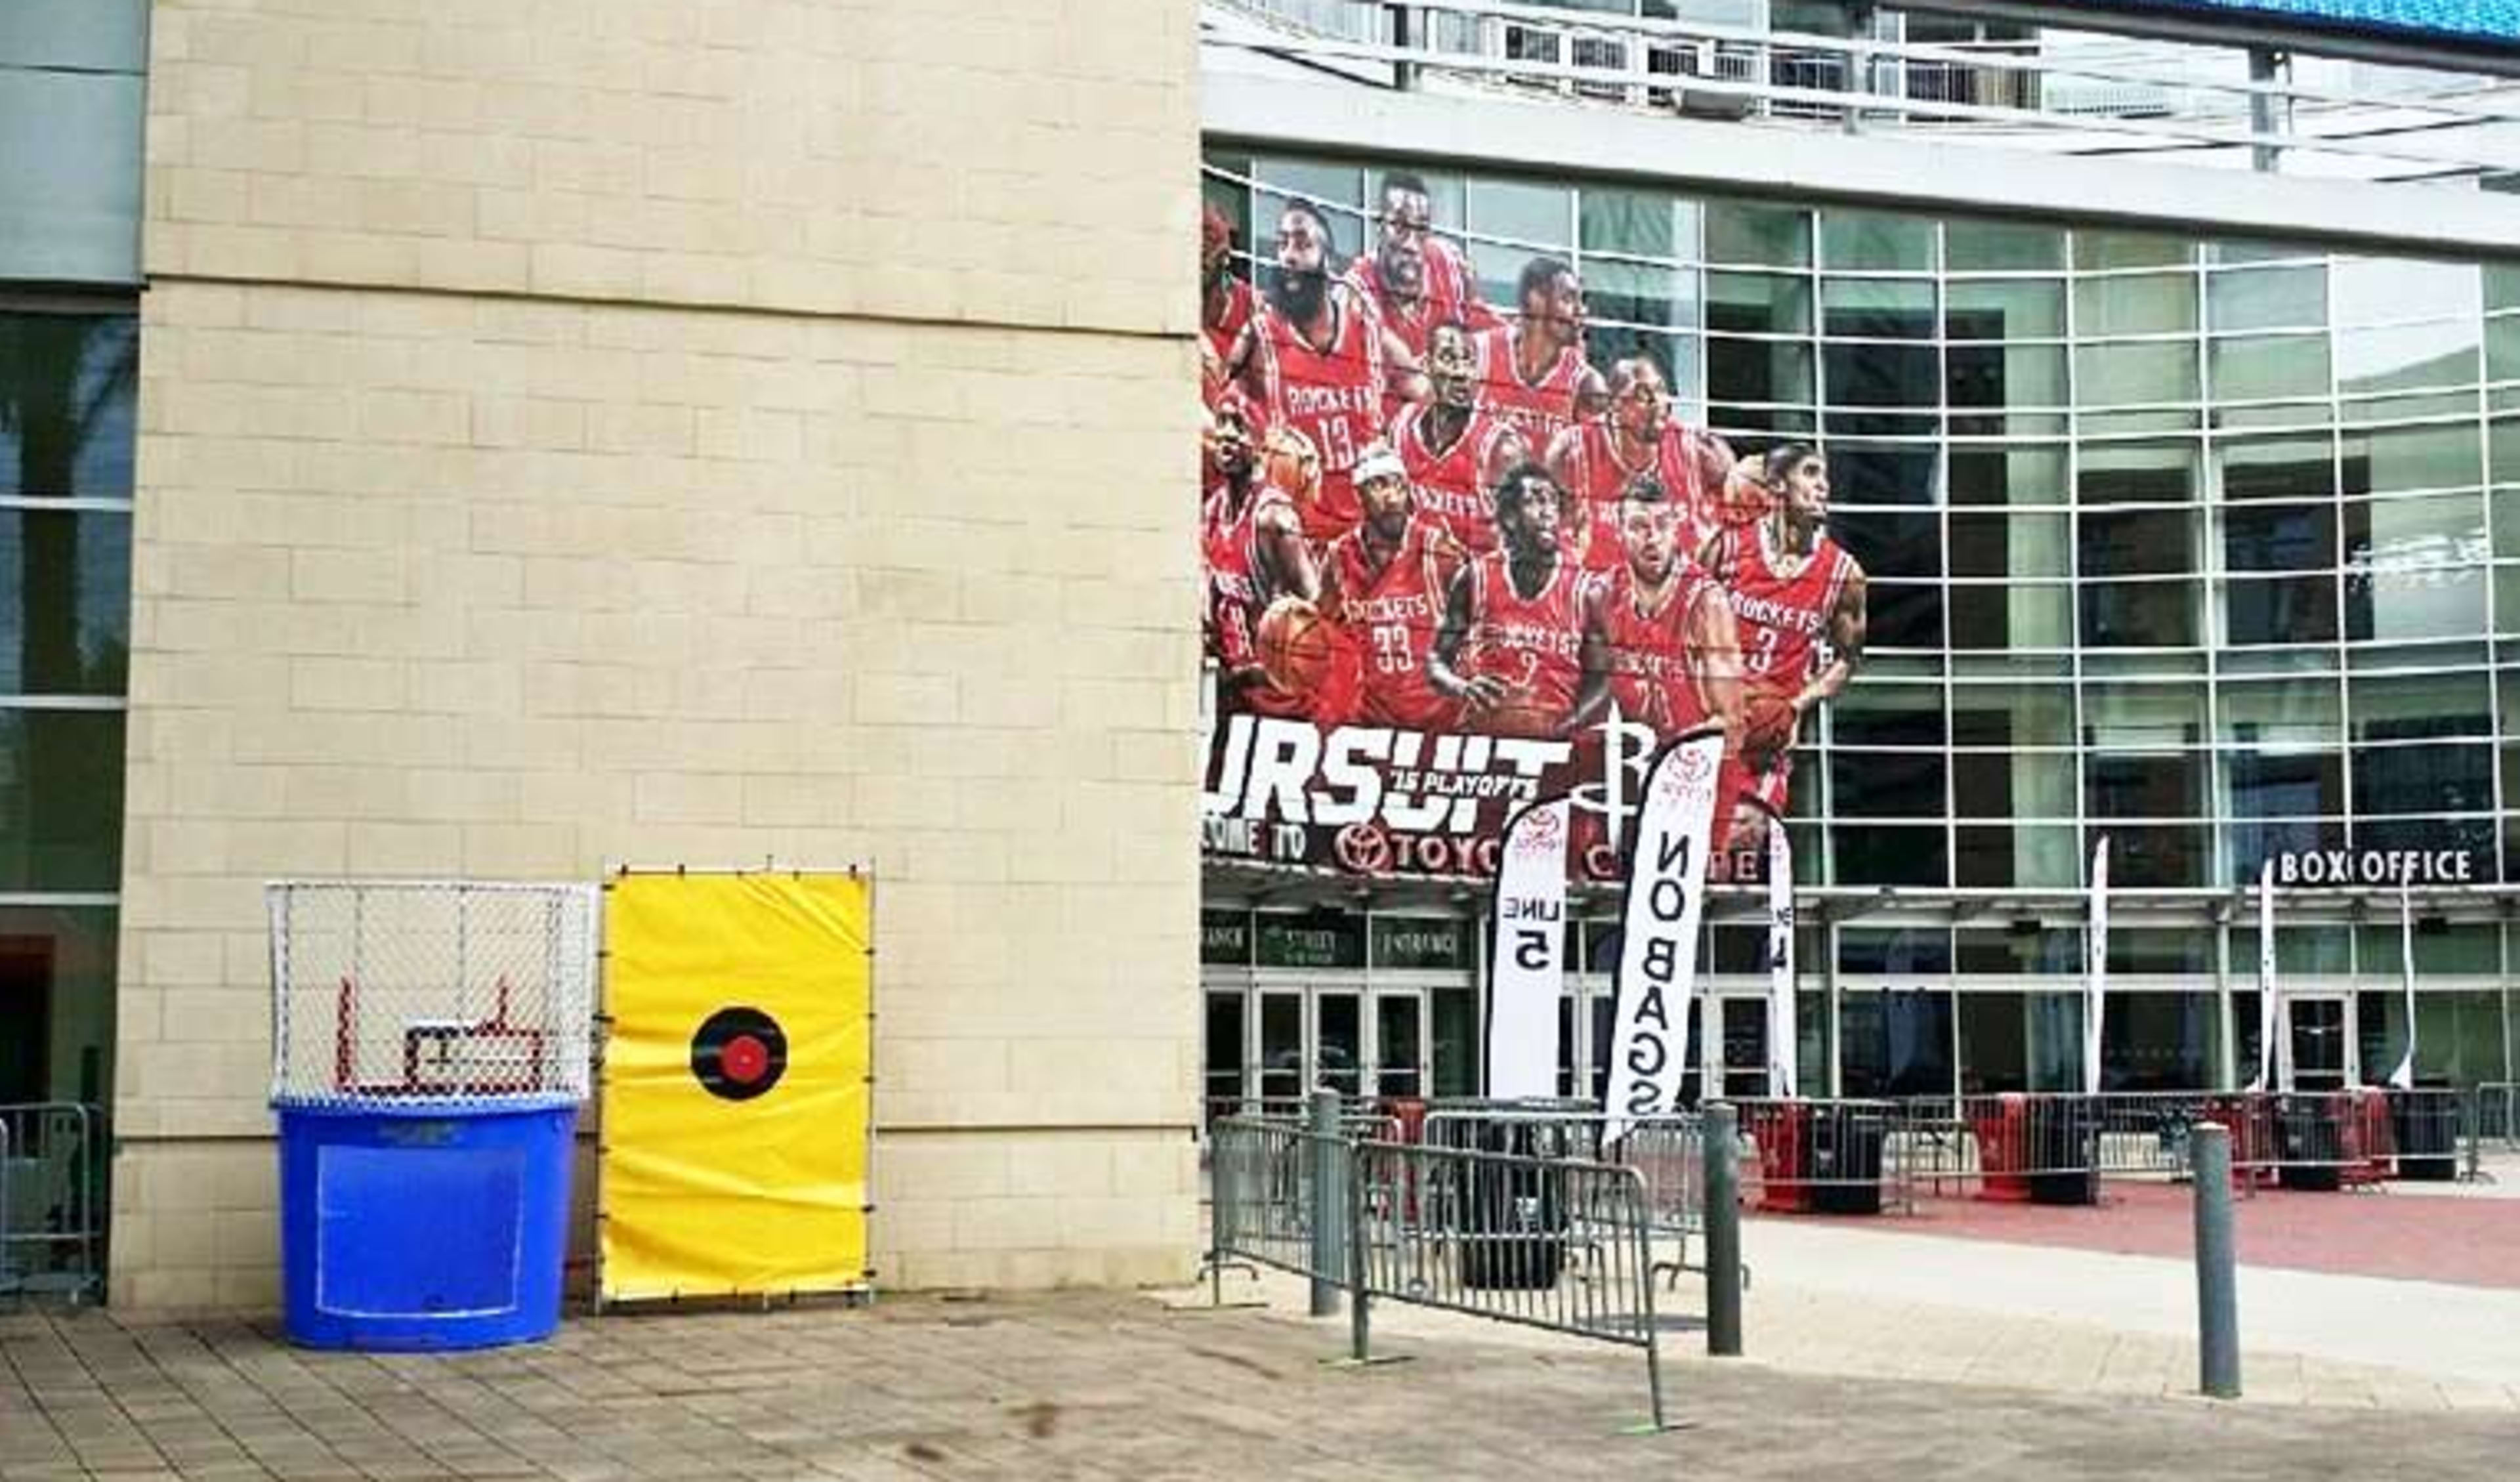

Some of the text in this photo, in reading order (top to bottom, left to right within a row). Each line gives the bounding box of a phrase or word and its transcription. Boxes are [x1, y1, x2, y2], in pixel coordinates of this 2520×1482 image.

[1318, 415, 1354, 470] 13
[1731, 591, 1820, 634] ROCKETS
[1373, 624, 1414, 673] 33
[1750, 627, 1778, 673] 3
[1423, 772, 1540, 799] PLAYOFFS
[1270, 824, 1307, 860] TO
[1391, 834, 1500, 872] TOYO
[2280, 851, 2471, 882] BOX OFFICE
